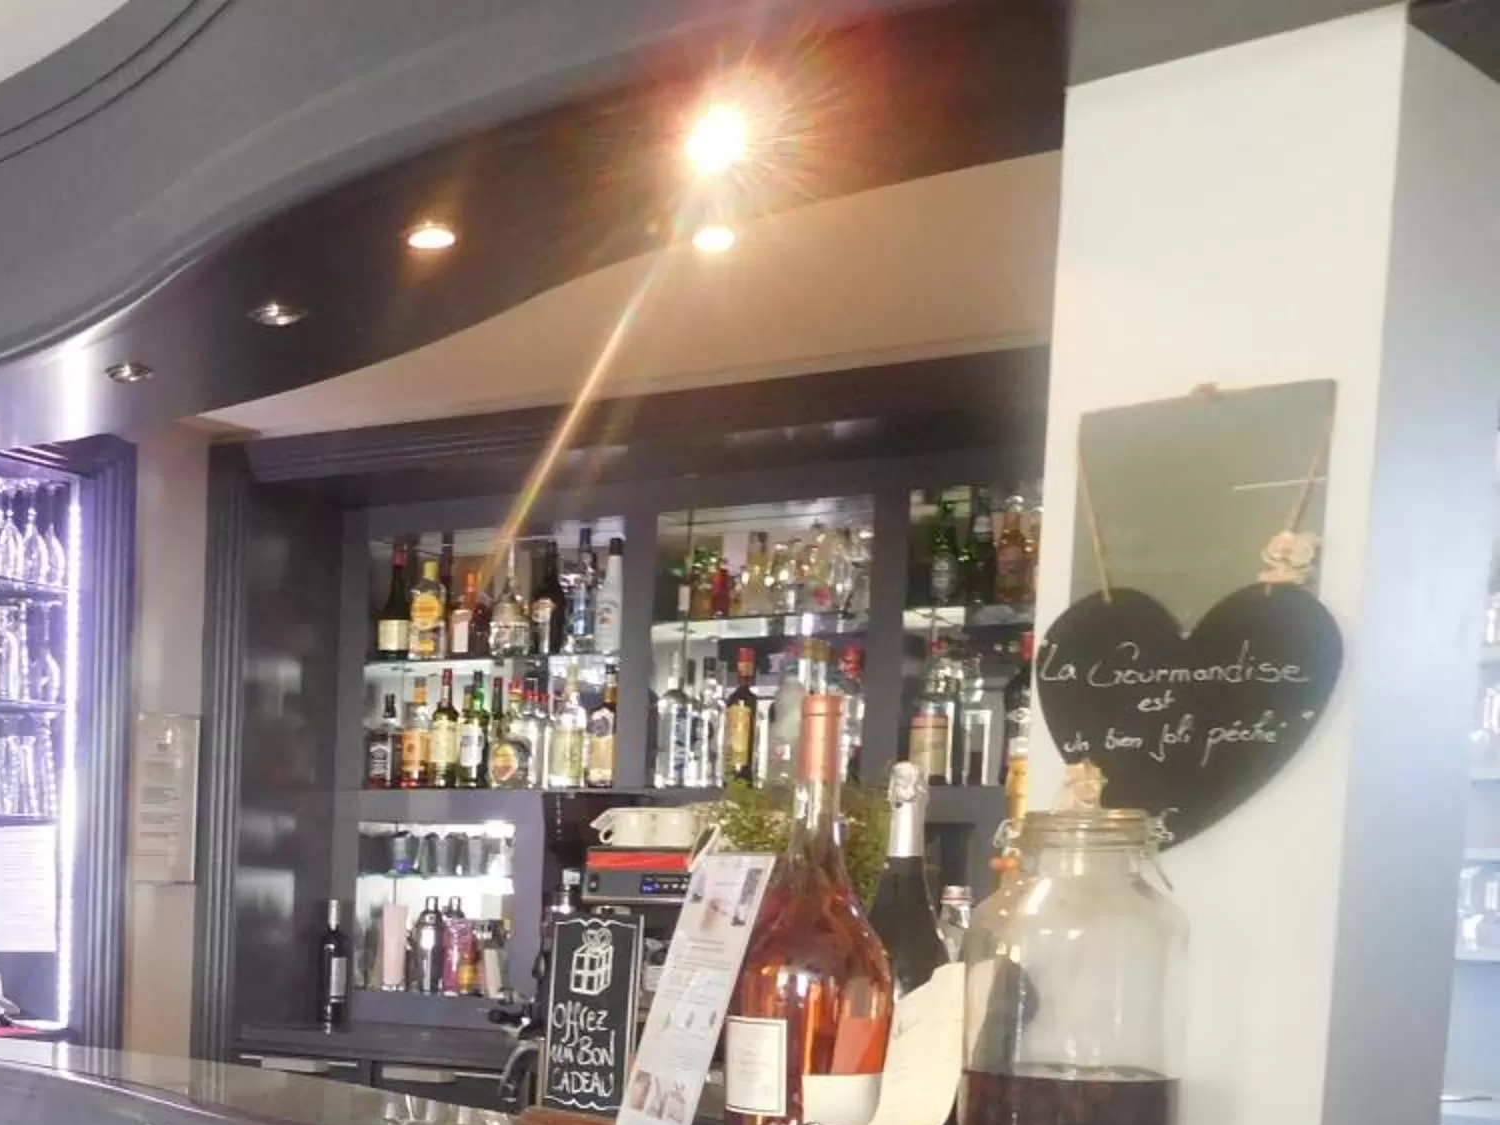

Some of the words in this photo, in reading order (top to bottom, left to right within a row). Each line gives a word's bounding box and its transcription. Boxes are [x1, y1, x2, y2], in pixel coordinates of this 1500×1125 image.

[1087, 640, 1309, 687] Gourmandise
[1137, 690, 1175, 712] est
[1104, 728, 1143, 750] bien
[1148, 713, 1194, 762] joli
[552, 1067, 614, 1097] CADEAU
